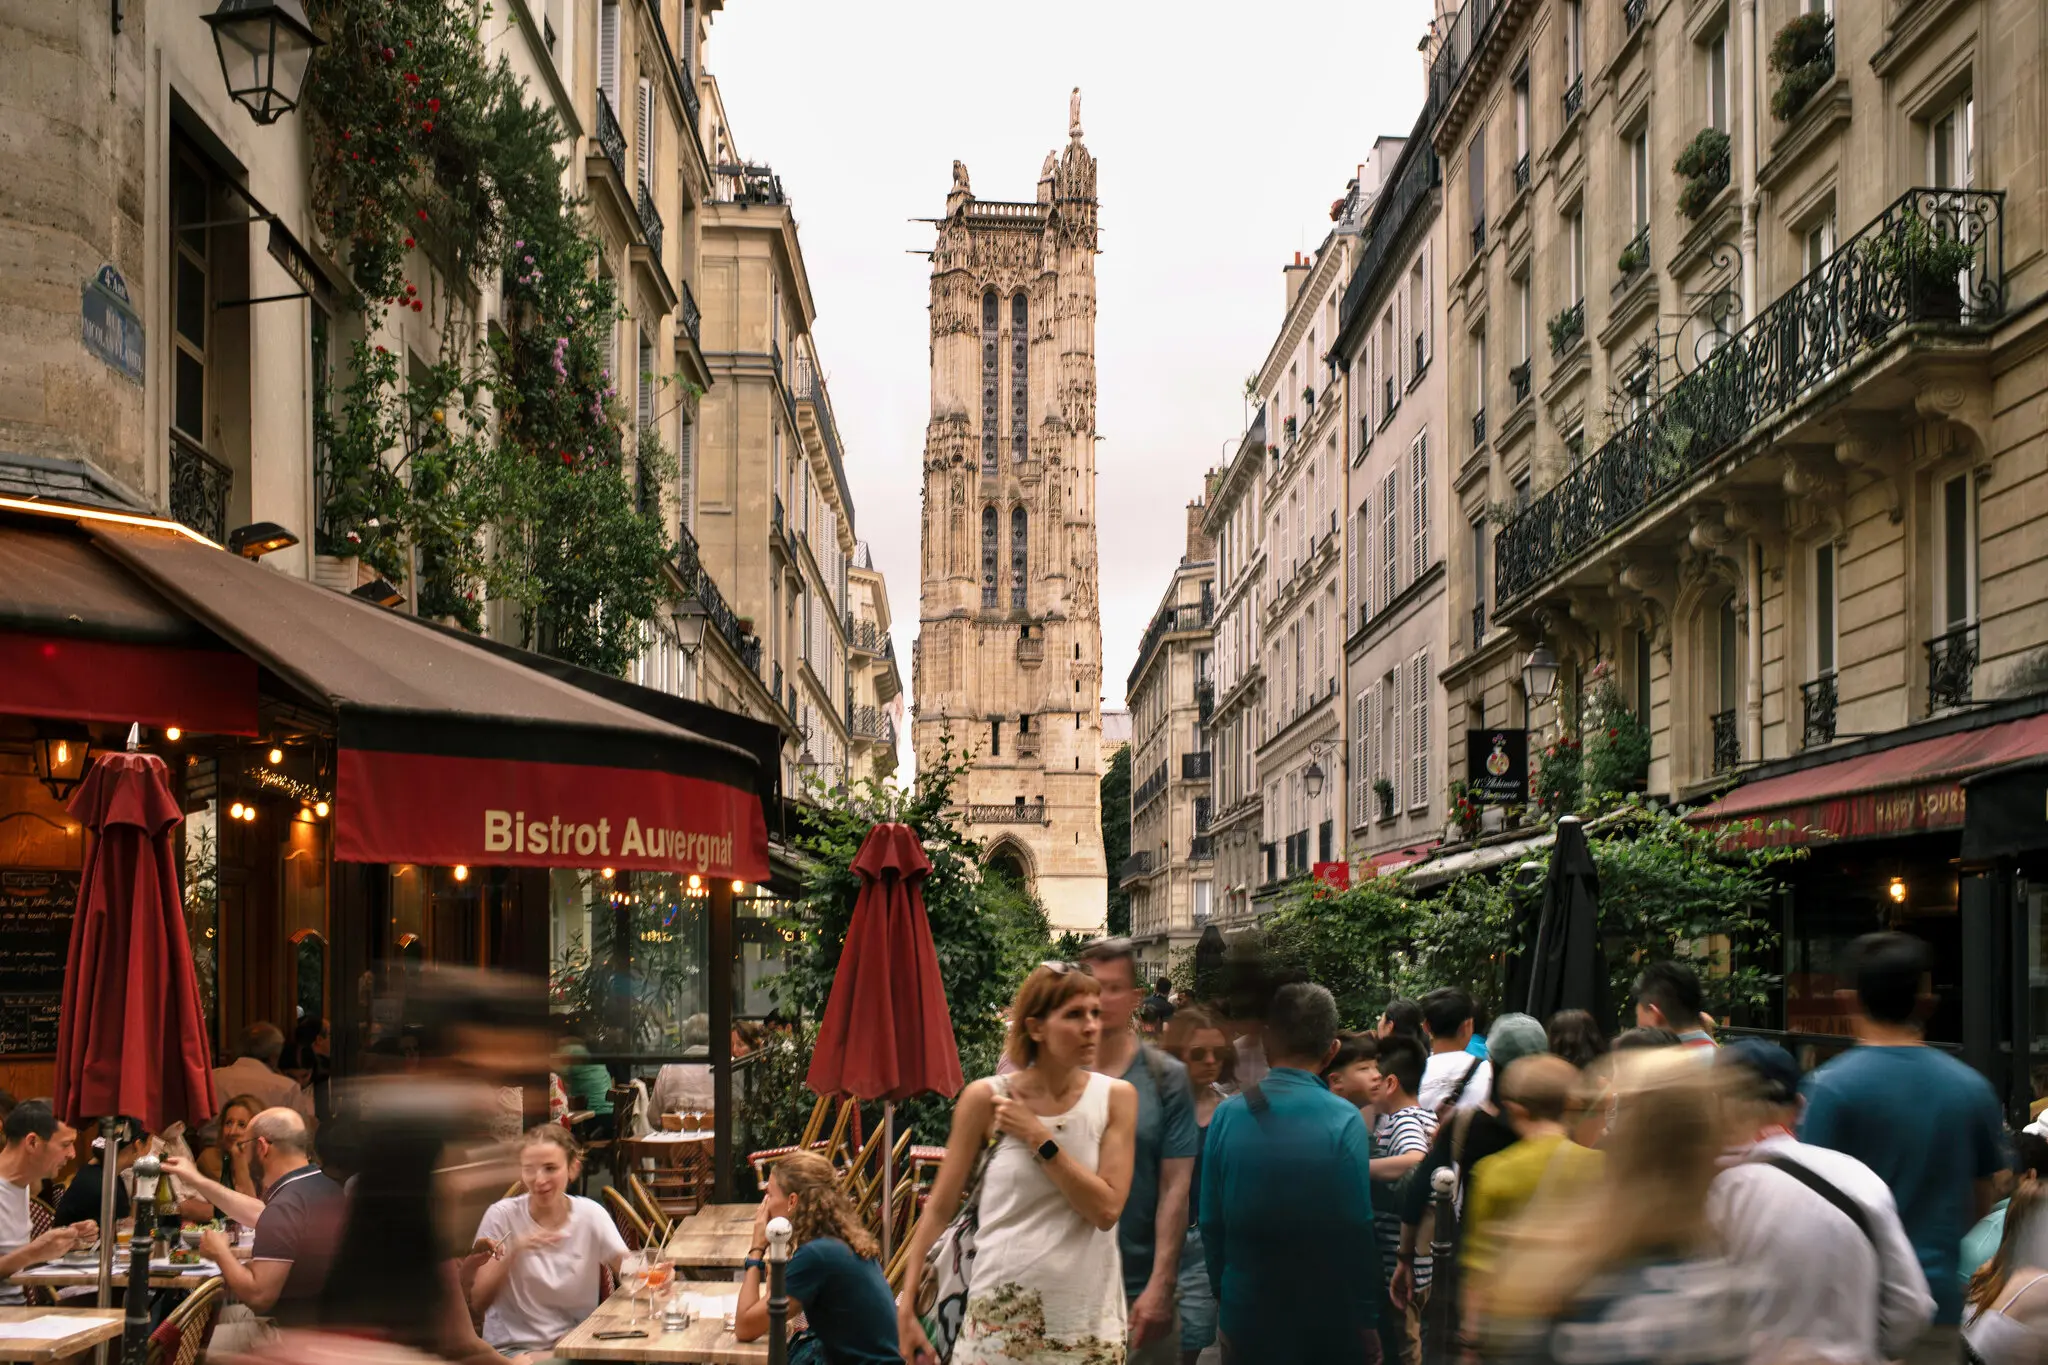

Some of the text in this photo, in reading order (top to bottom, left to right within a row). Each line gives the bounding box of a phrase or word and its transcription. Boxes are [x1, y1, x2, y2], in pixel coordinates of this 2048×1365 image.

[1875, 795, 1915, 824] HAPPY
[485, 809, 733, 872] Bistrot Auvergnat
